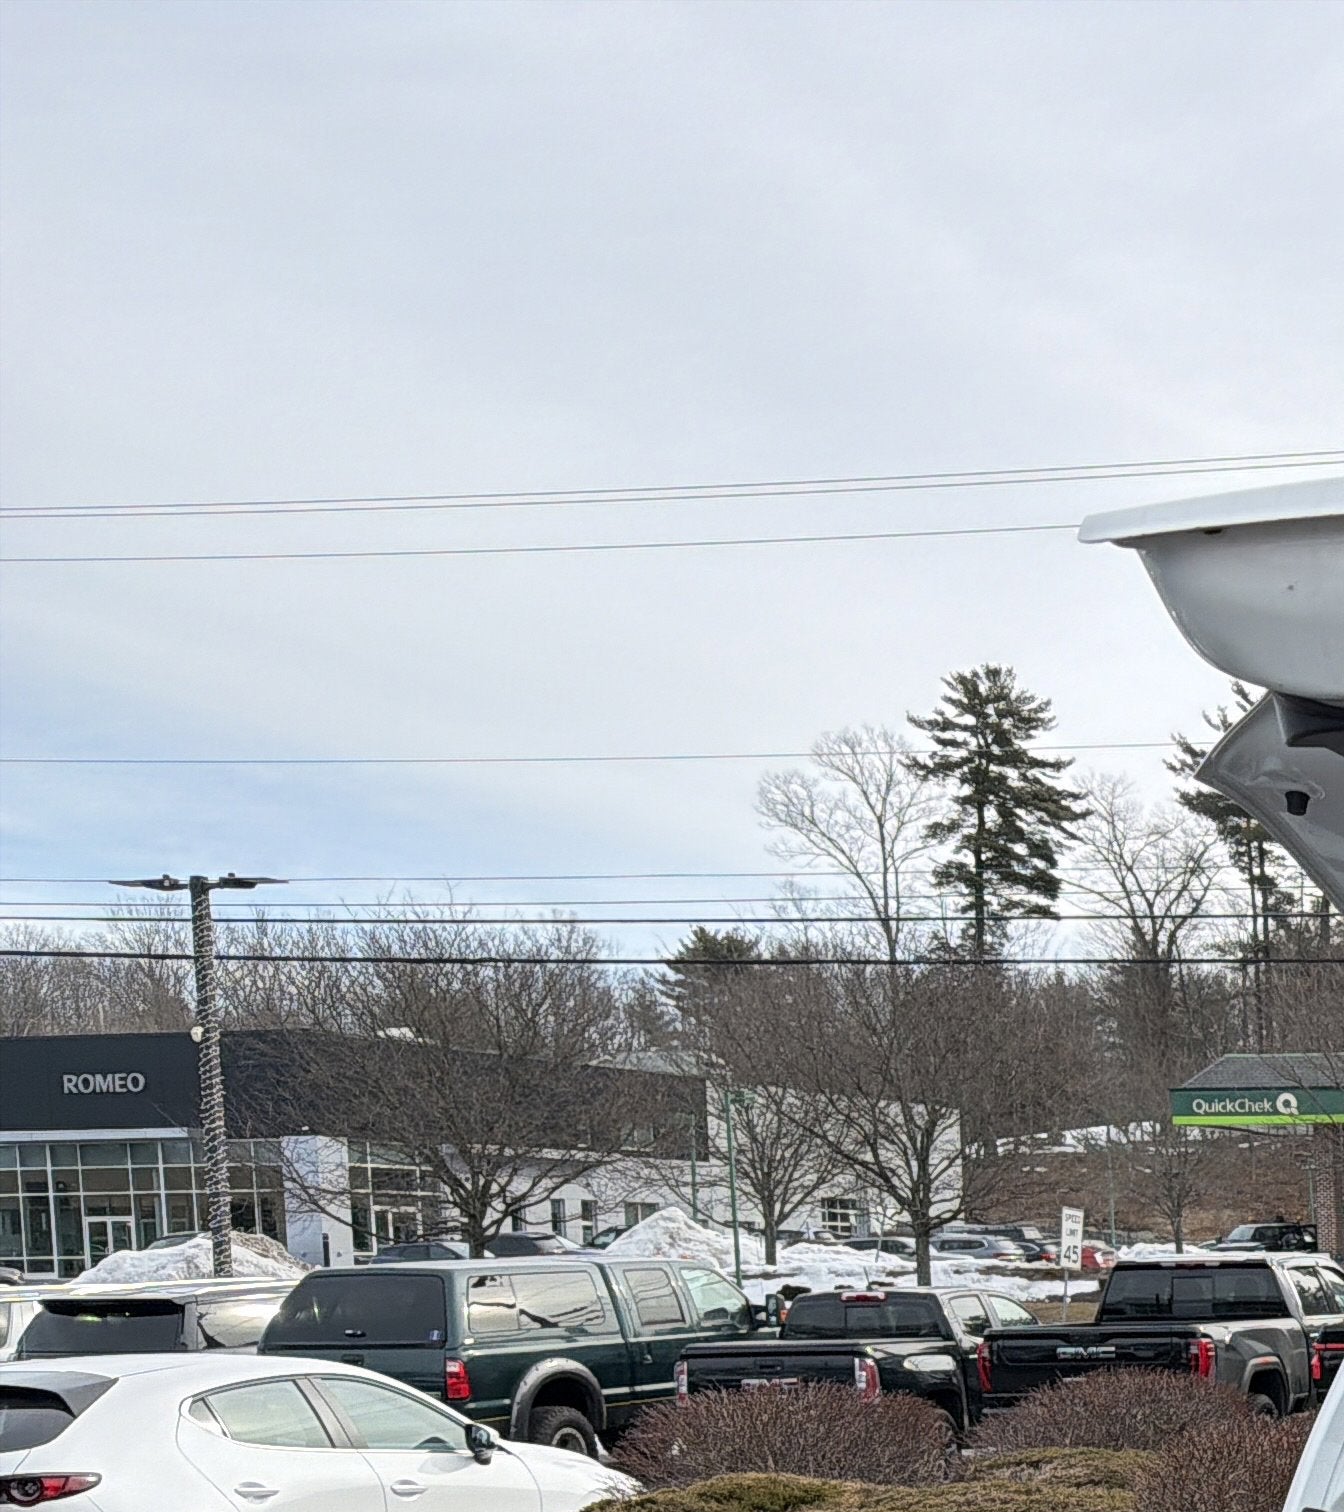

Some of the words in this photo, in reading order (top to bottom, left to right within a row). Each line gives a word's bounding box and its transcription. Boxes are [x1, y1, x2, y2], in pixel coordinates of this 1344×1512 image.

[62, 1072, 146, 1094] ROMEO
[1192, 1098, 1274, 1115] QuickChek
[1064, 1213, 1081, 1225] SPEED
[1063, 1245, 1079, 1264] 45
[1055, 1346, 1116, 1360] GMC
